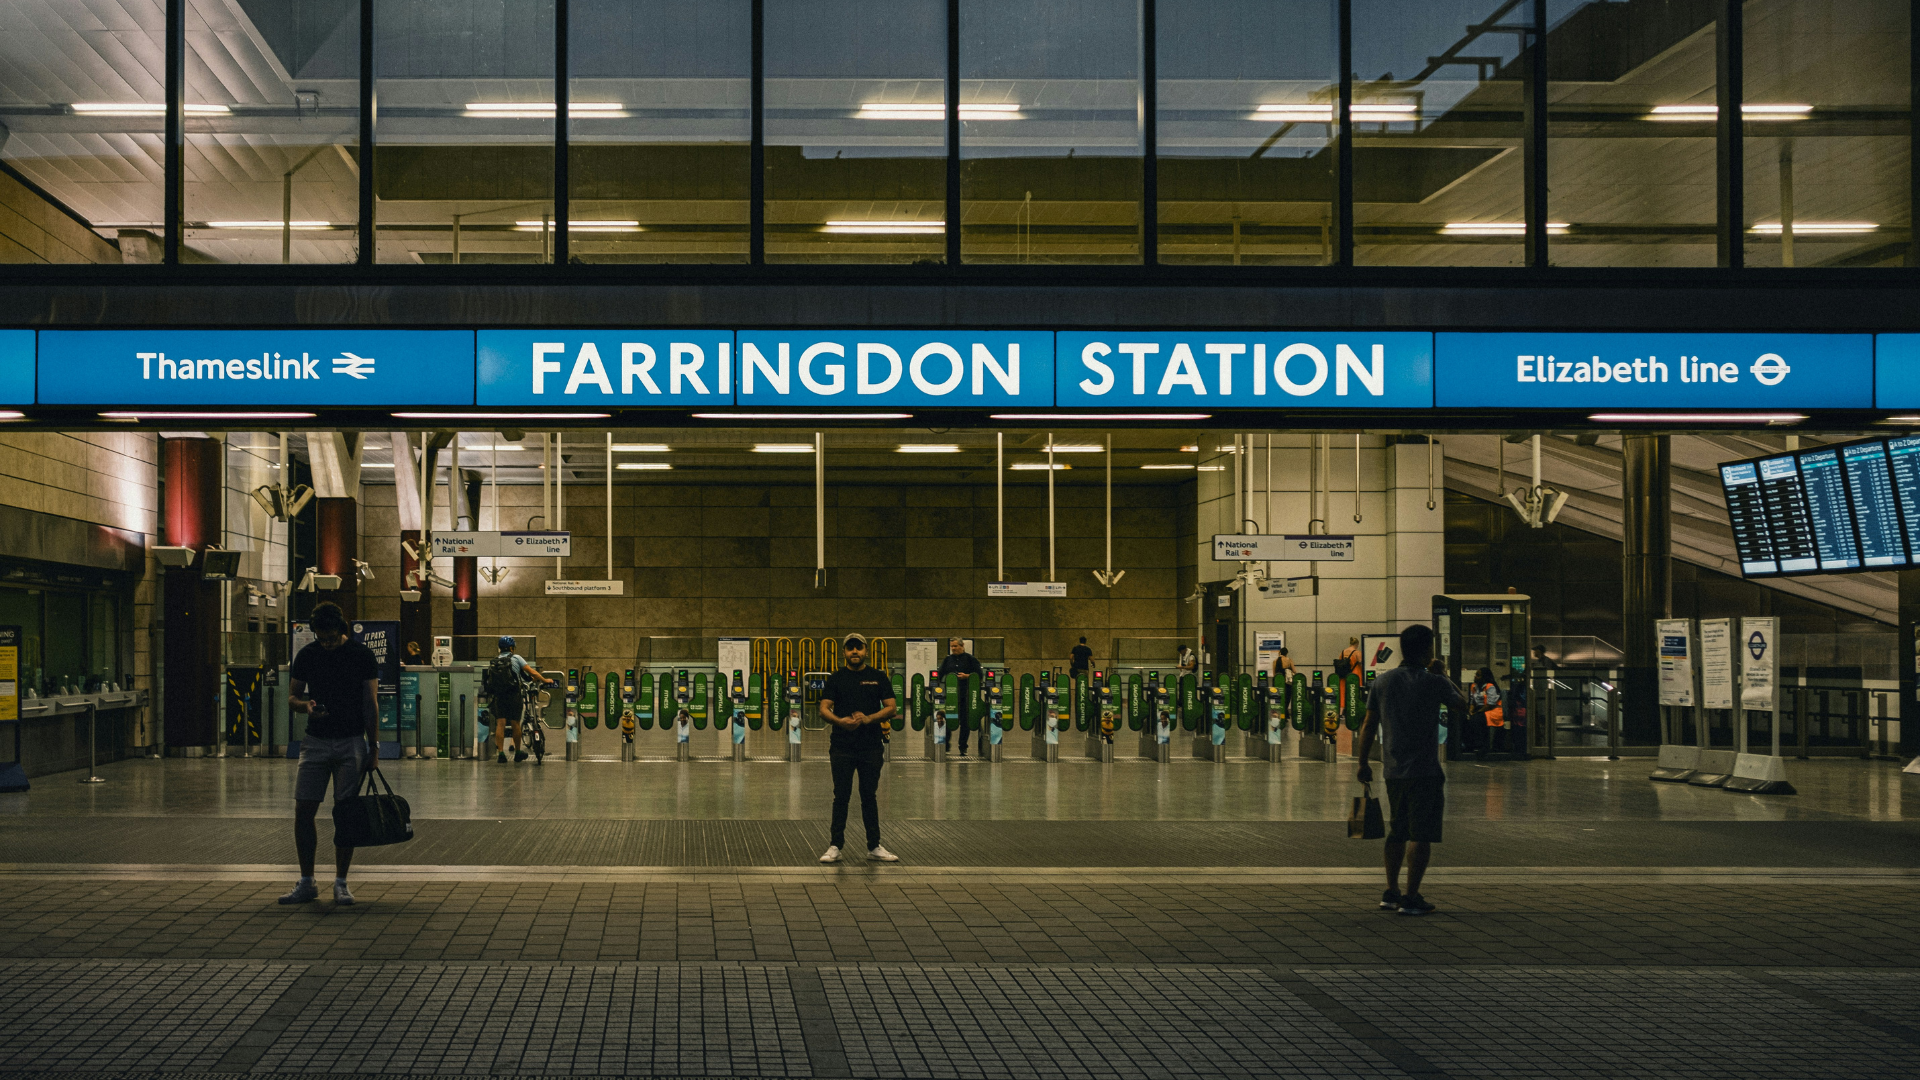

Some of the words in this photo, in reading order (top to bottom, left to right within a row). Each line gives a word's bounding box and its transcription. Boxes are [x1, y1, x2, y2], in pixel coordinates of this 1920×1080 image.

[136, 352, 320, 380] Thameslink
[532, 341, 1020, 396] FARRINGDON
[1079, 342, 1384, 397] STATION
[1517, 355, 1668, 383] Elizabeth
[1681, 355, 1739, 383] line
[1860, 444, 1883, 453] Departures
[442, 537, 474, 545] National
[526, 537, 560, 545] Elizabeth
[364, 633, 370, 641] IT
[370, 630, 386, 640] PAYS
[367, 639, 387, 648] TRAVEL
